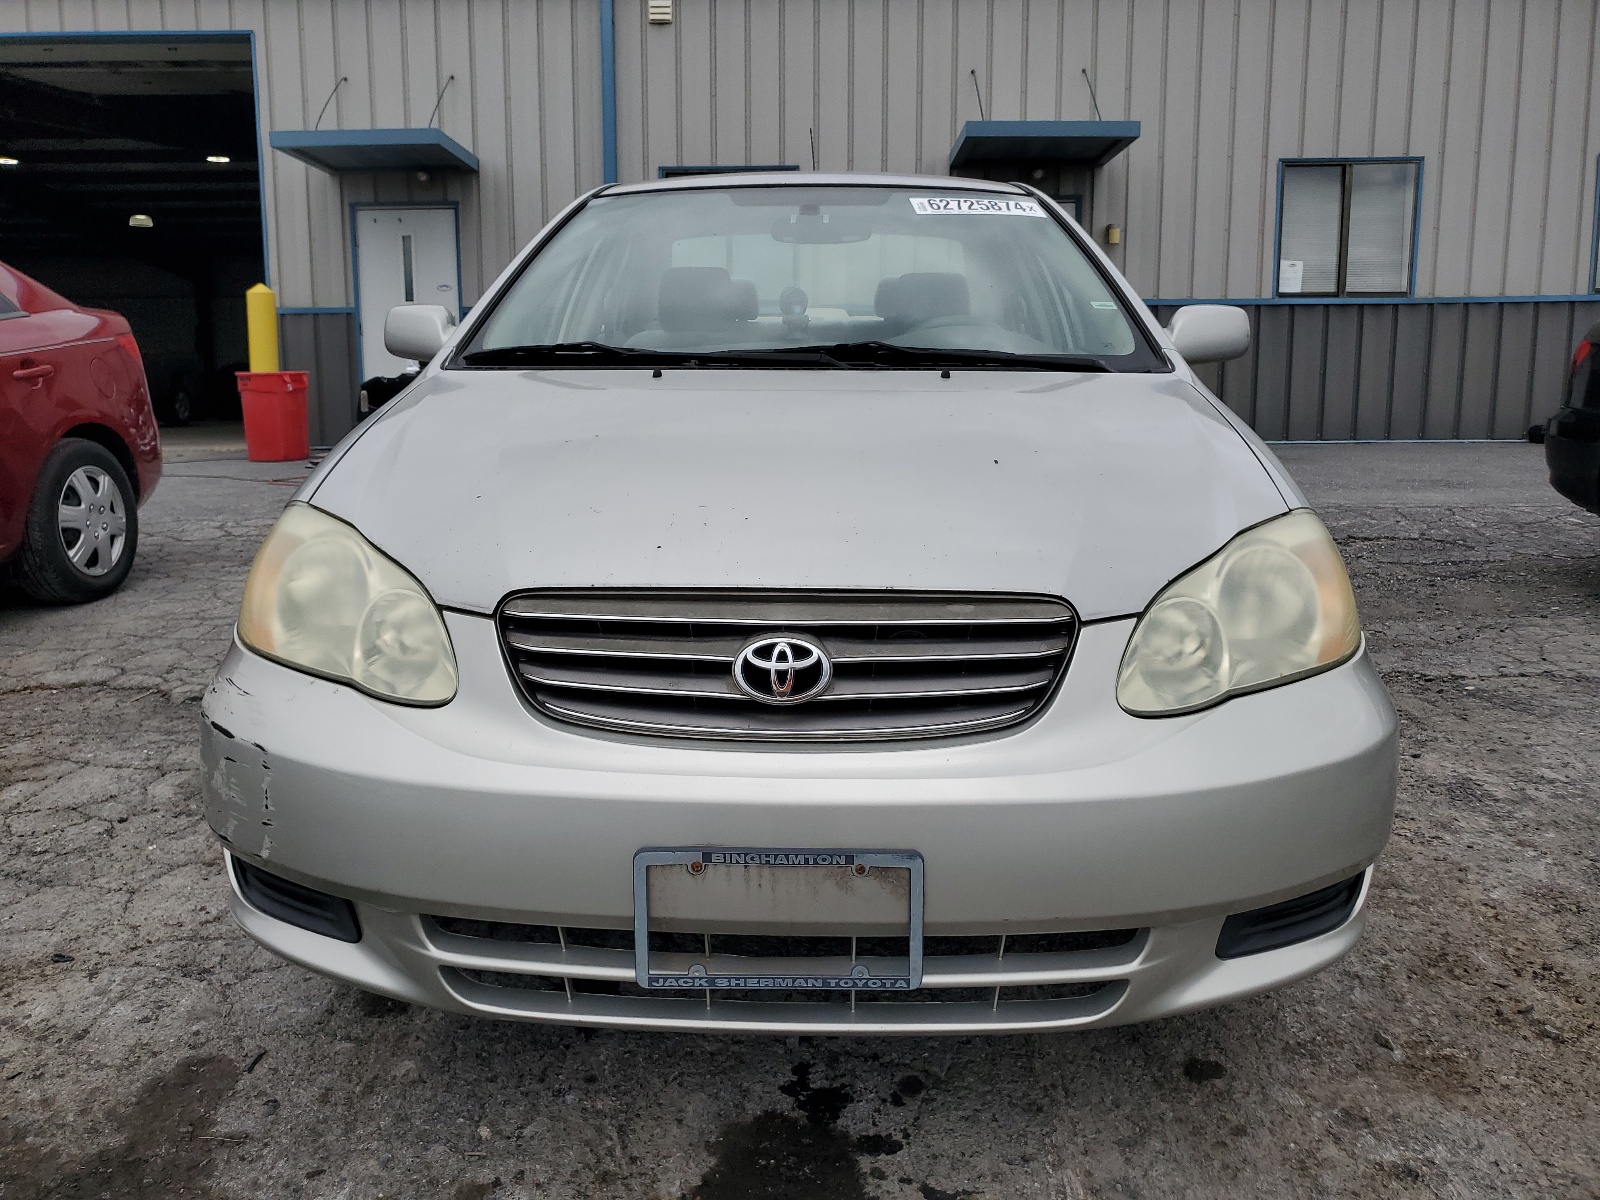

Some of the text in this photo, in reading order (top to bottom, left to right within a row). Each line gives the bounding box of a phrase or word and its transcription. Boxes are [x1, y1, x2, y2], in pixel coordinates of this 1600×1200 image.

[711, 853, 846, 865] BINGHAMTON
[651, 978, 908, 989] JACK SHERMAN TOYOTA
